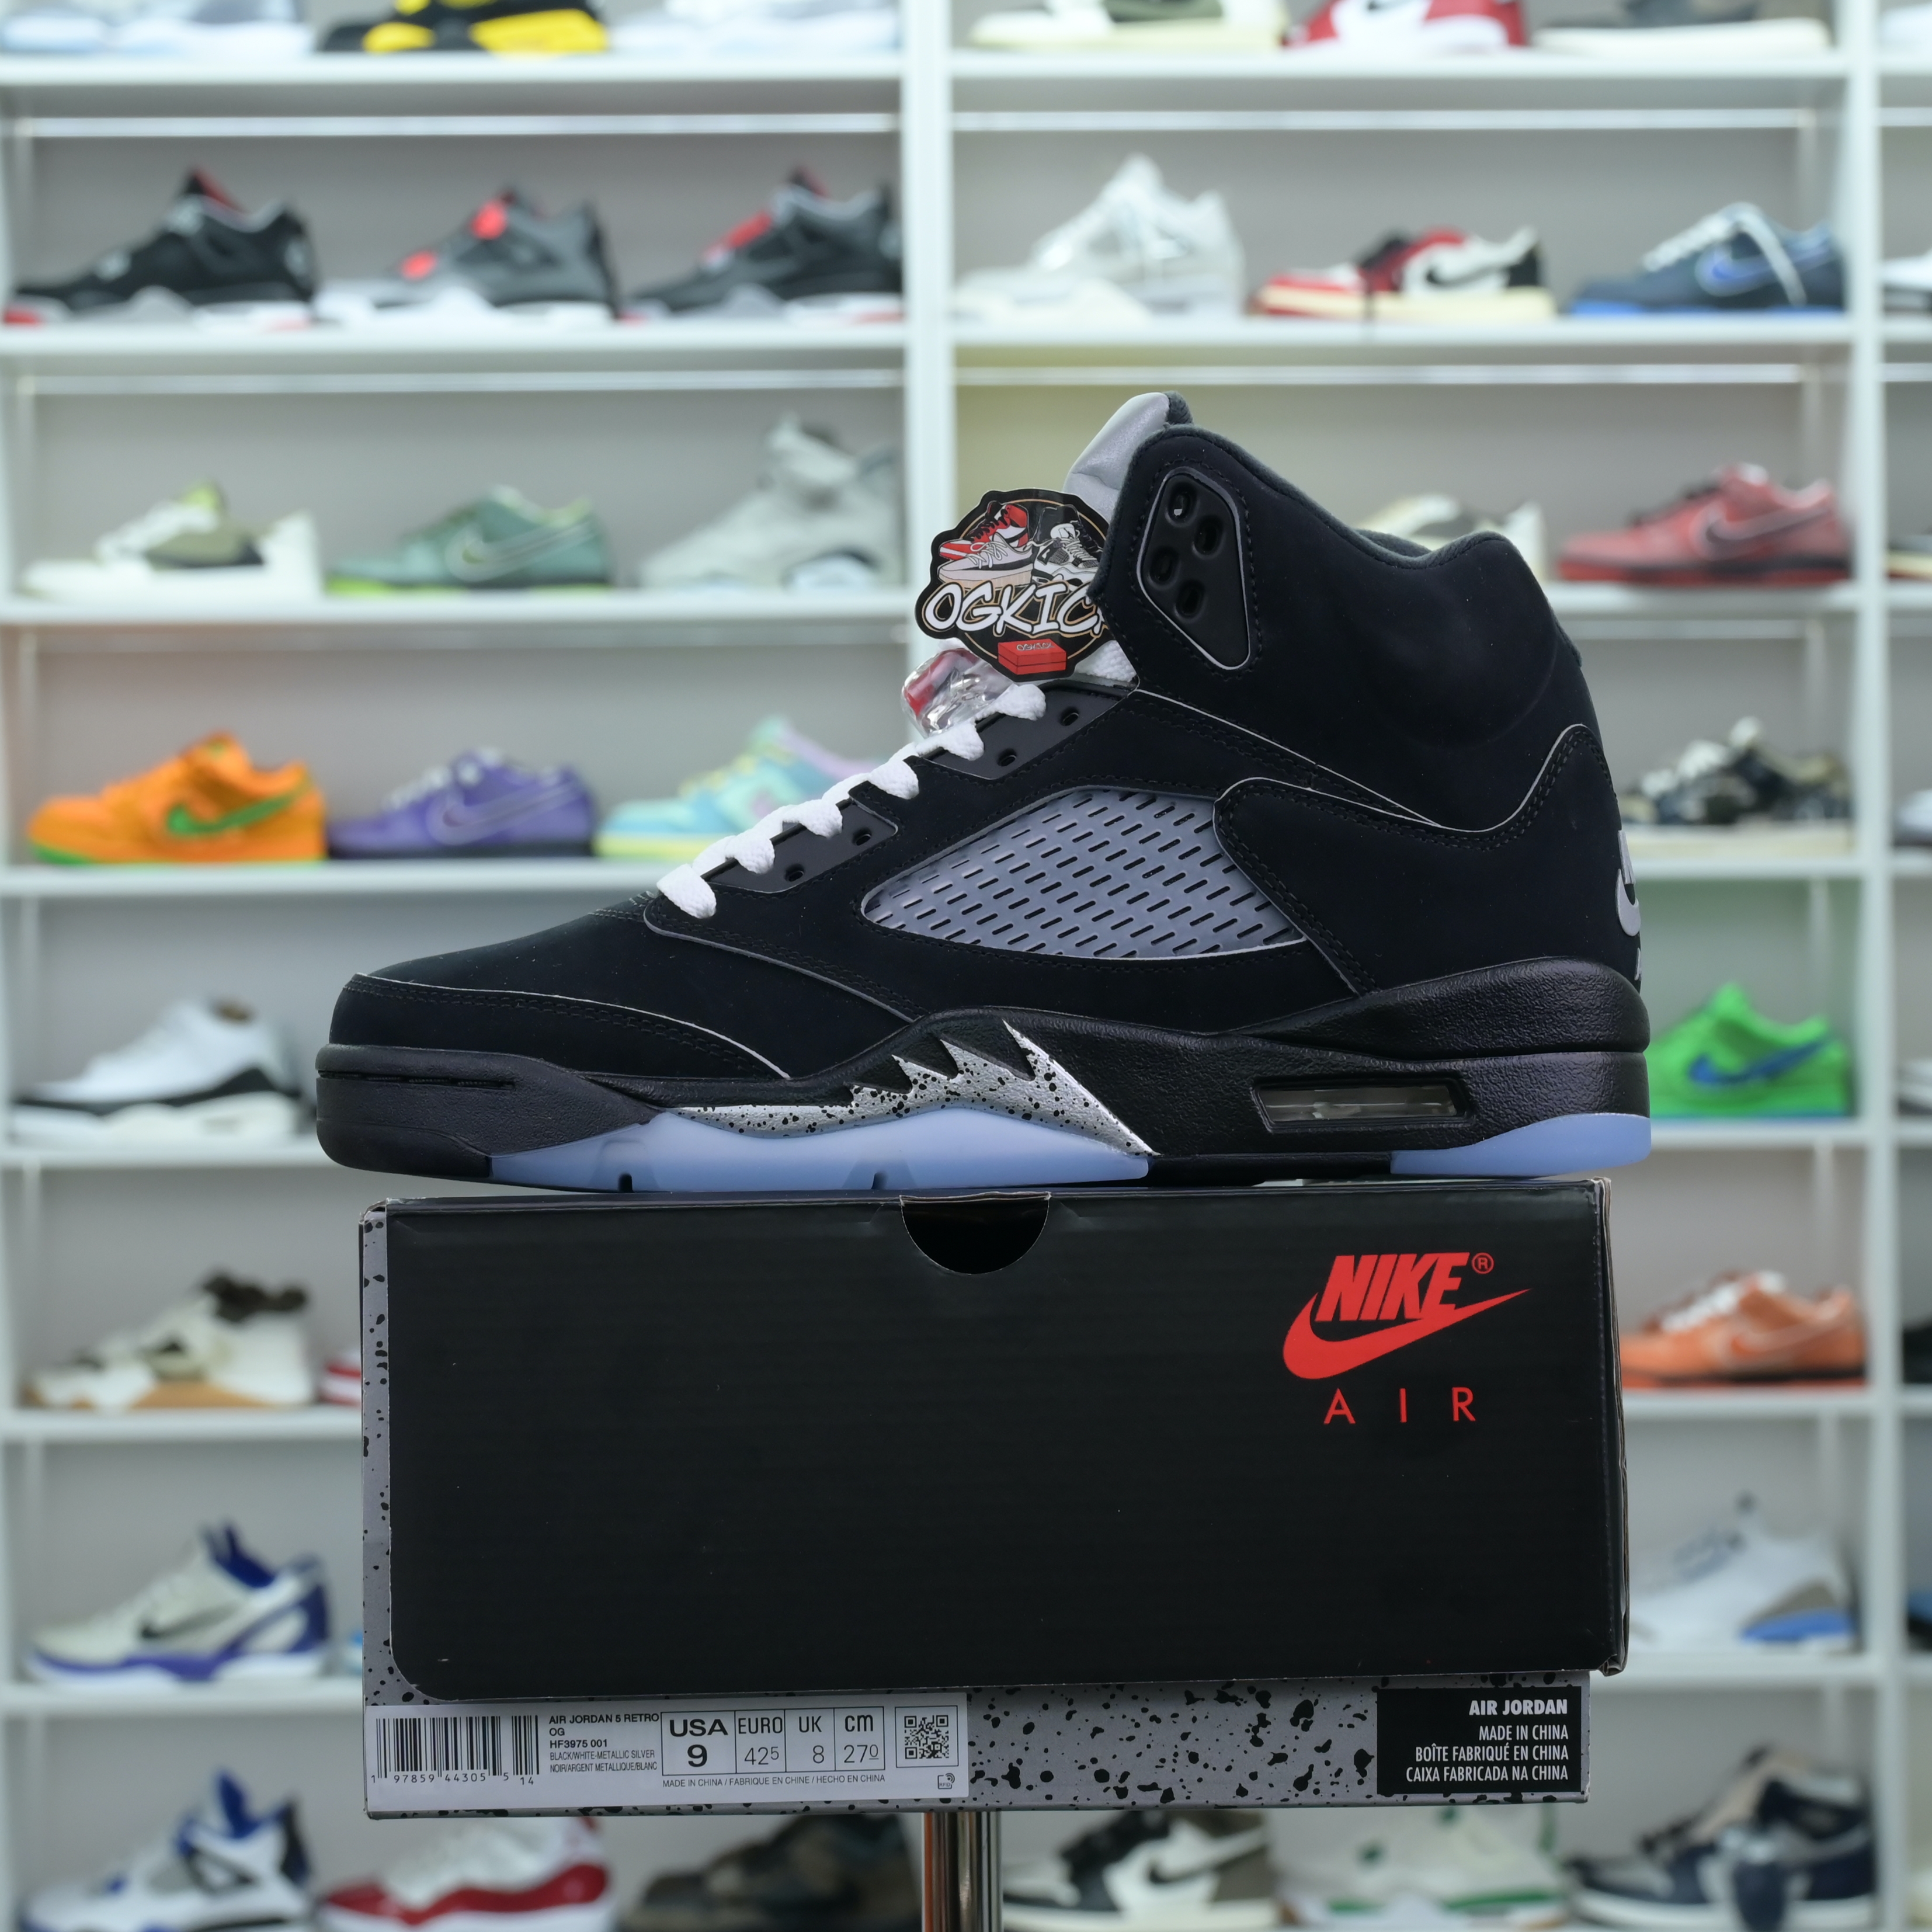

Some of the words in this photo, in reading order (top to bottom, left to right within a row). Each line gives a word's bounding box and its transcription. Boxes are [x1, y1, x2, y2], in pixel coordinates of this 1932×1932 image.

[1469, 1700, 1497, 1715] AIR
[1502, 1698, 1568, 1715] JORDAN
[549, 1716, 567, 1724] AIR
[569, 1714, 613, 1723] JORDAN
[615, 1714, 621, 1722] 5
[624, 1713, 659, 1722] RETRO
[738, 1716, 783, 1734] EURO
[799, 1715, 822, 1733] UK
[845, 1715, 873, 1732] cm
[549, 1728, 565, 1736] OG
[669, 1718, 728, 1737] USA
[1479, 1725, 1512, 1741] MADE
[1516, 1725, 1528, 1740] IN
[1532, 1724, 1569, 1740] CHINA
[550, 1739, 588, 1749] HF3975
[590, 1739, 607, 1747] 001
[1416, 1743, 1448, 1762] BOÎTE
[1453, 1742, 1510, 1761] FABRIQUÉ
[1514, 1745, 1528, 1761] EN
[1532, 1745, 1569, 1760] CHINA
[631, 1750, 655, 1759] SILVER
[687, 1744, 707, 1767] 9
[812, 1745, 824, 1764] 8
[550, 1763, 593, 1773] NOIR/ARGENT
[1406, 1766, 1440, 1782] CAIXA
[1444, 1766, 1508, 1781] FABRICADA
[1512, 1766, 1528, 1781] NA
[1532, 1765, 1569, 1780] CHINA
[371, 1775, 376, 1783] 1
[503, 1773, 509, 1781] 5
[729, 1777, 769, 1785] FABRIQUE
[785, 1776, 809, 1784] CHINE
